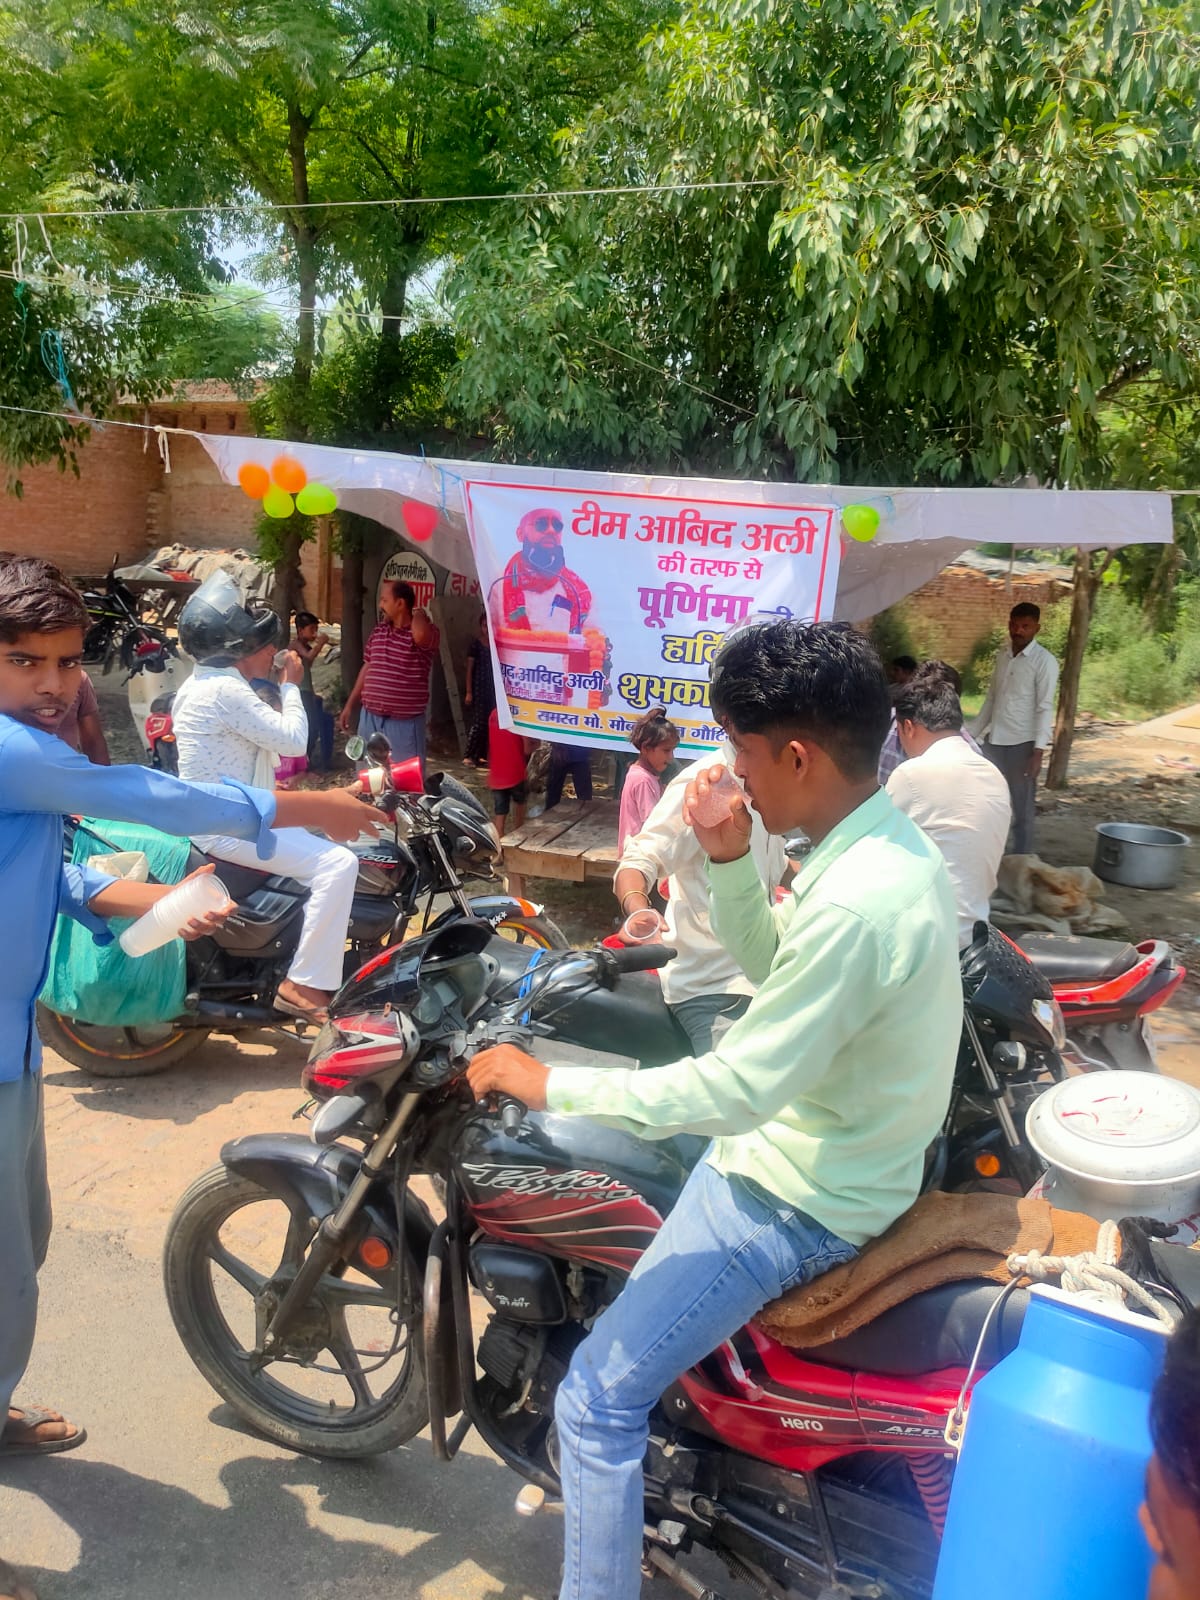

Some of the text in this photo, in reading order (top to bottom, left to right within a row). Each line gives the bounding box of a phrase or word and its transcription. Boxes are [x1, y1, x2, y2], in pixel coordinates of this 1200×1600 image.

[571, 500, 818, 555] टीम आबिद अली
[657, 550, 763, 580] की तरफ से
[638, 582, 754, 629] पूर्णिमा
[567, 671, 605, 691] अली
[618, 673, 711, 709] शुभका
[538, 710, 579, 726] समस्त
[553, 1190, 638, 1201] PRO
[780, 1416, 824, 1432] Hero
